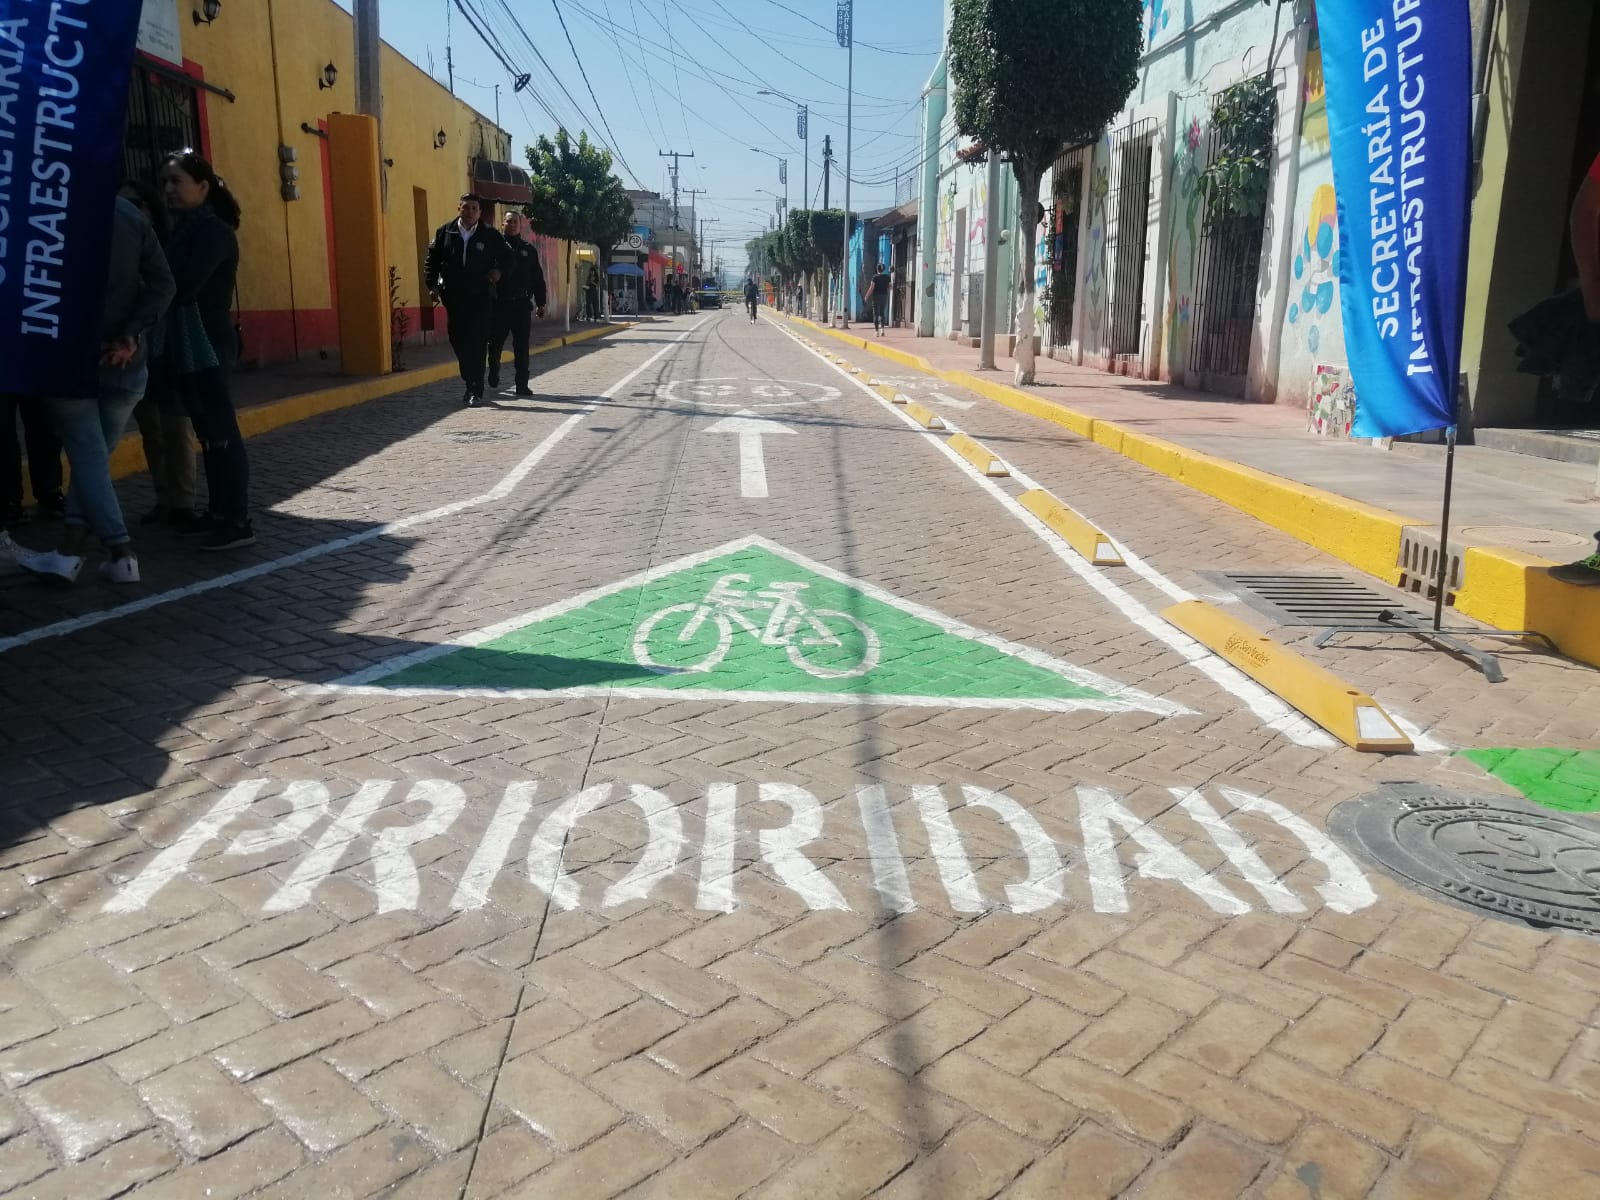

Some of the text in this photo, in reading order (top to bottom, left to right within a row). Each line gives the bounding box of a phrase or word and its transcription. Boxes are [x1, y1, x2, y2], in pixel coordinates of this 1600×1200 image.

[21, 0, 90, 338] INFRAESTRUCT
[1361, 18, 1400, 340] SECRETARÍA DE
[100, 778, 1378, 915] PRIORIDAD
